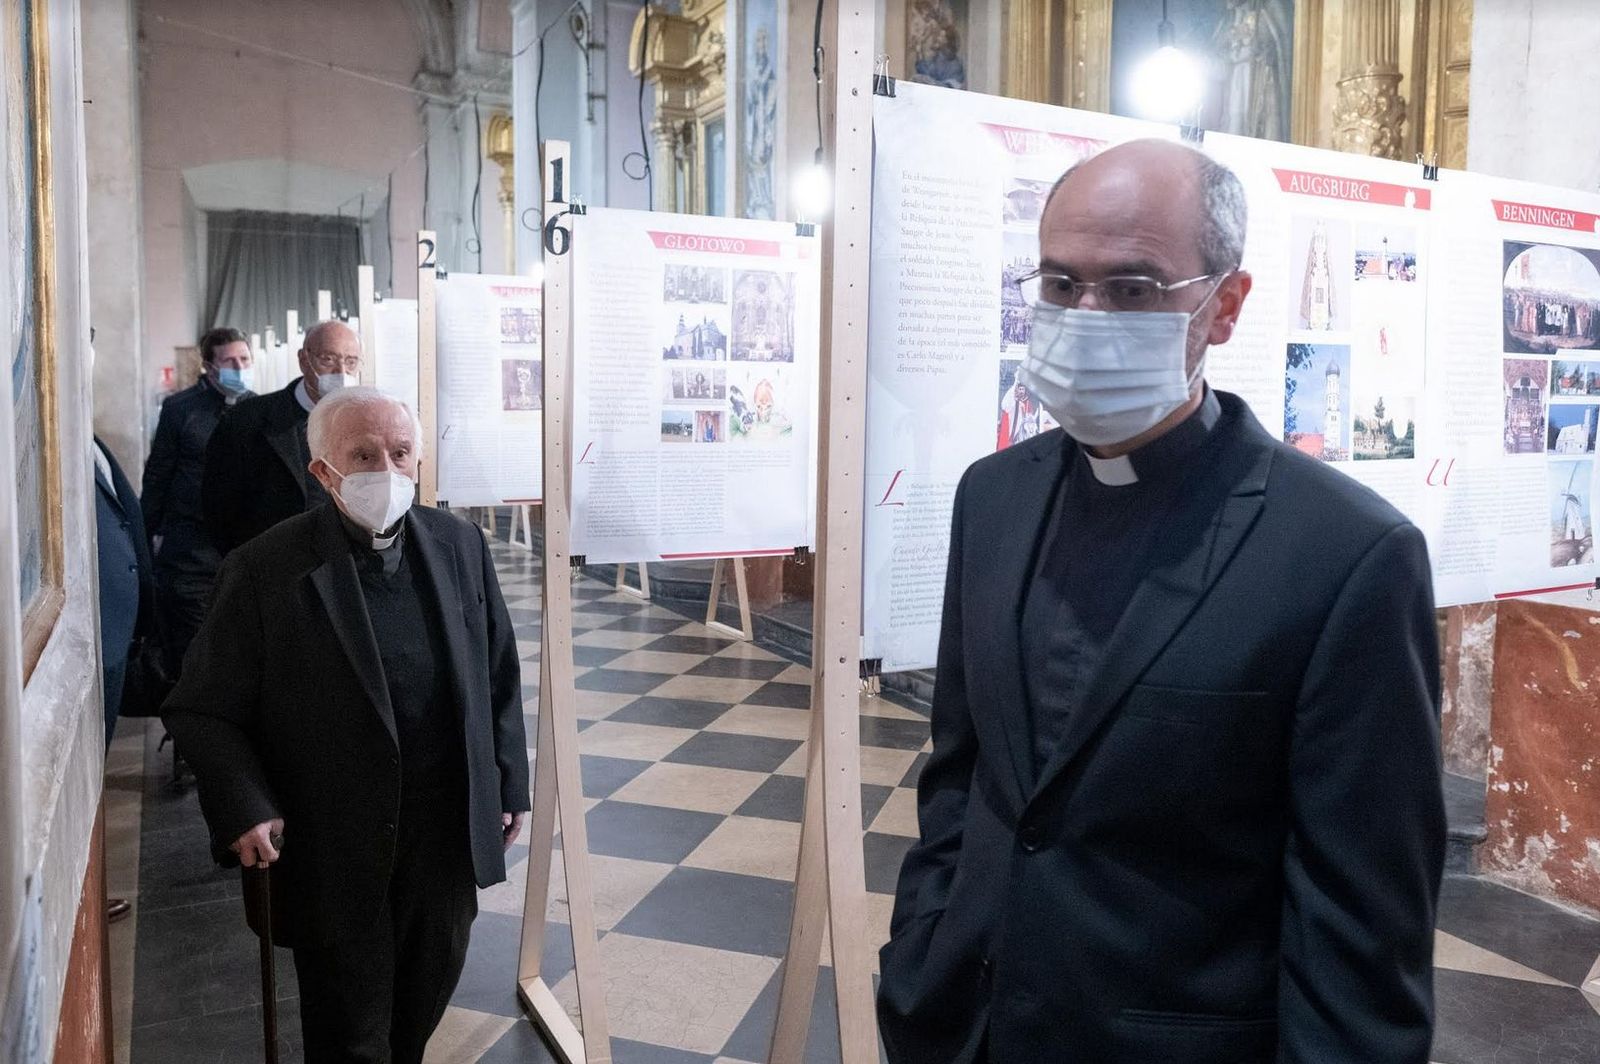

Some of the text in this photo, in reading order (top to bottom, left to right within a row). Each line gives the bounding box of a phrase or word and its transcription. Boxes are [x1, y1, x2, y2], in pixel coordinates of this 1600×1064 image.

[1290, 174, 1370, 201] AUGSBURG
[1503, 204, 1576, 228] BENNINGEN
[418, 238, 436, 269] 2
[664, 234, 746, 253] GLOTOWO
